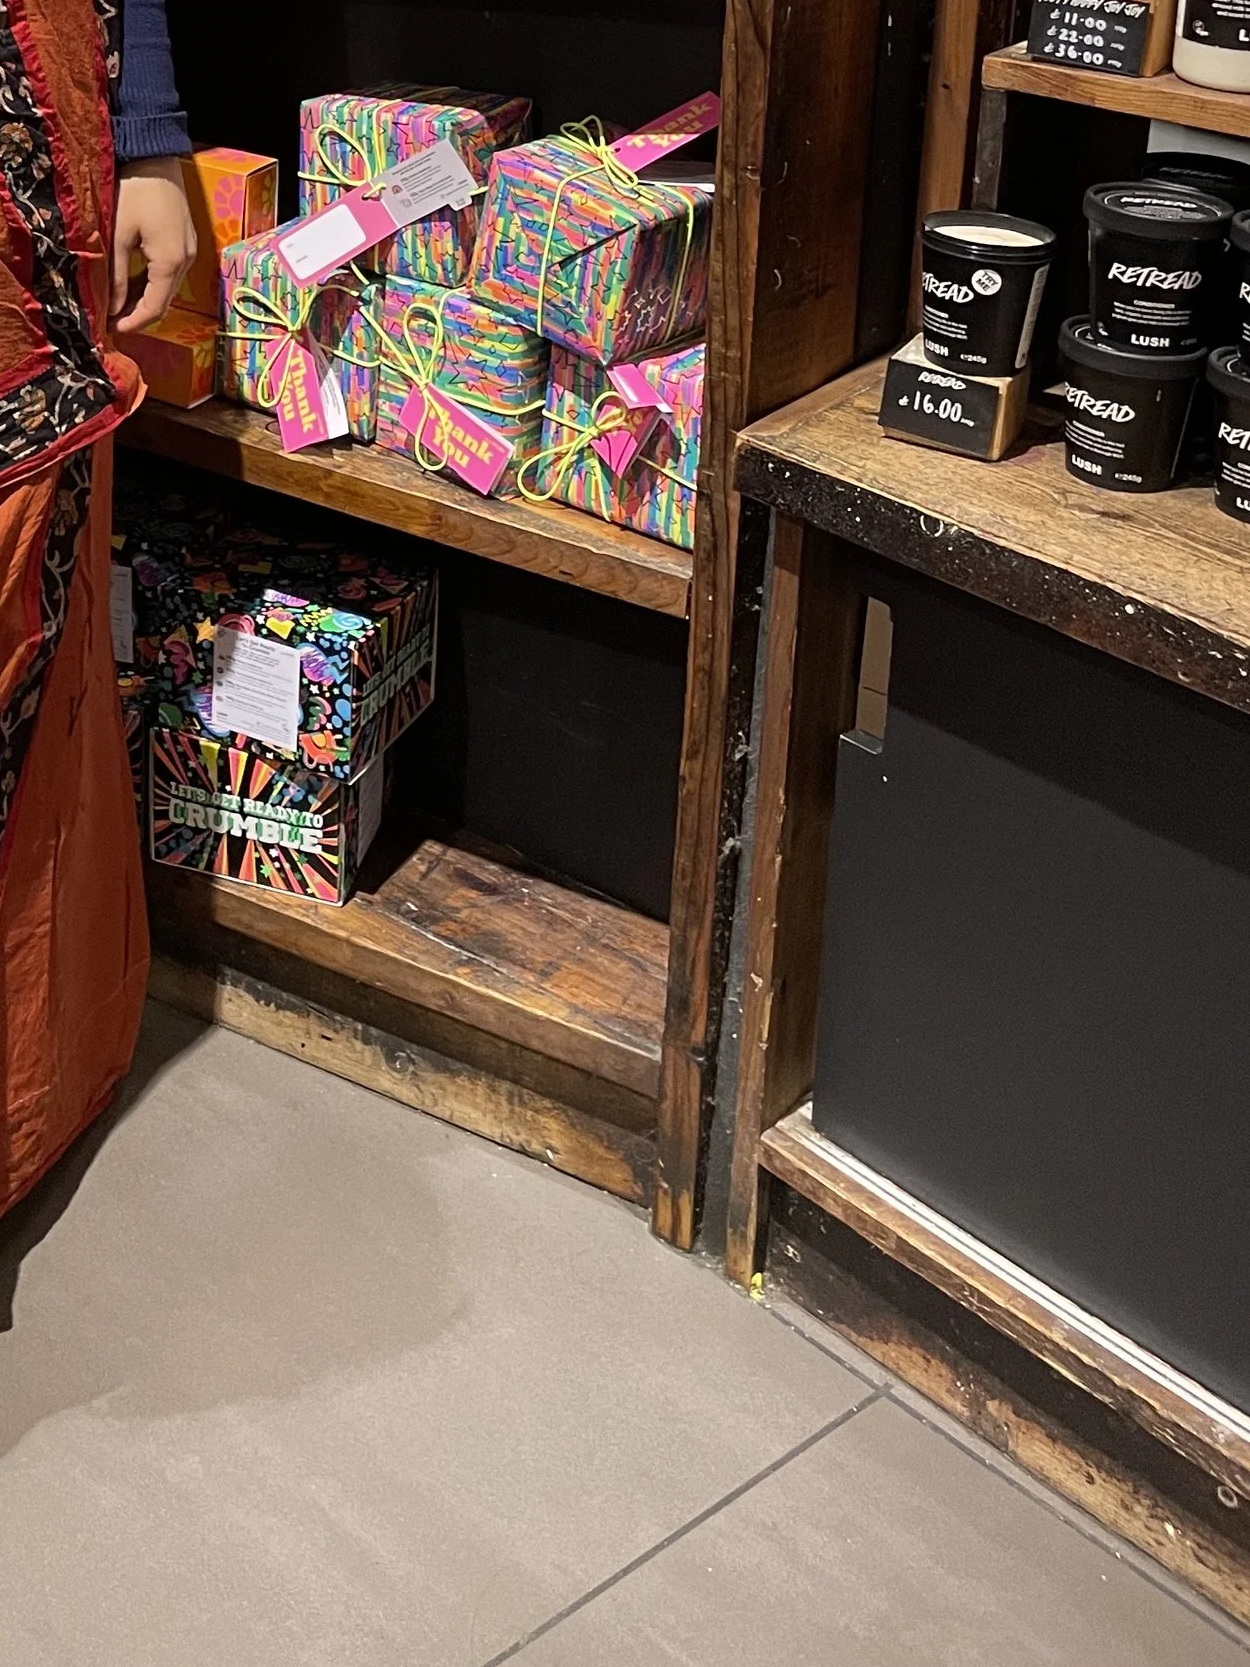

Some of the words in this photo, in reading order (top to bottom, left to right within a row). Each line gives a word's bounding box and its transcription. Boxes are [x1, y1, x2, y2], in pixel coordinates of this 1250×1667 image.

[626, 102, 713, 149] Thank
[922, 272, 974, 304] TREAD
[975, 278, 991, 293] ME
[1107, 262, 1203, 290] RETREAD
[925, 338, 949, 357] LUSH
[1131, 333, 1170, 348] LUSH
[290, 348, 317, 433] Thank
[898, 390, 963, 422] £16.00
[429, 405, 494, 465] Thank
[1071, 453, 1103, 476] LUSH
[168, 798, 324, 854] CRUMBLE
[211, 791, 241, 812] GET
[243, 798, 299, 825] READY
[299, 811, 324, 829] TO
